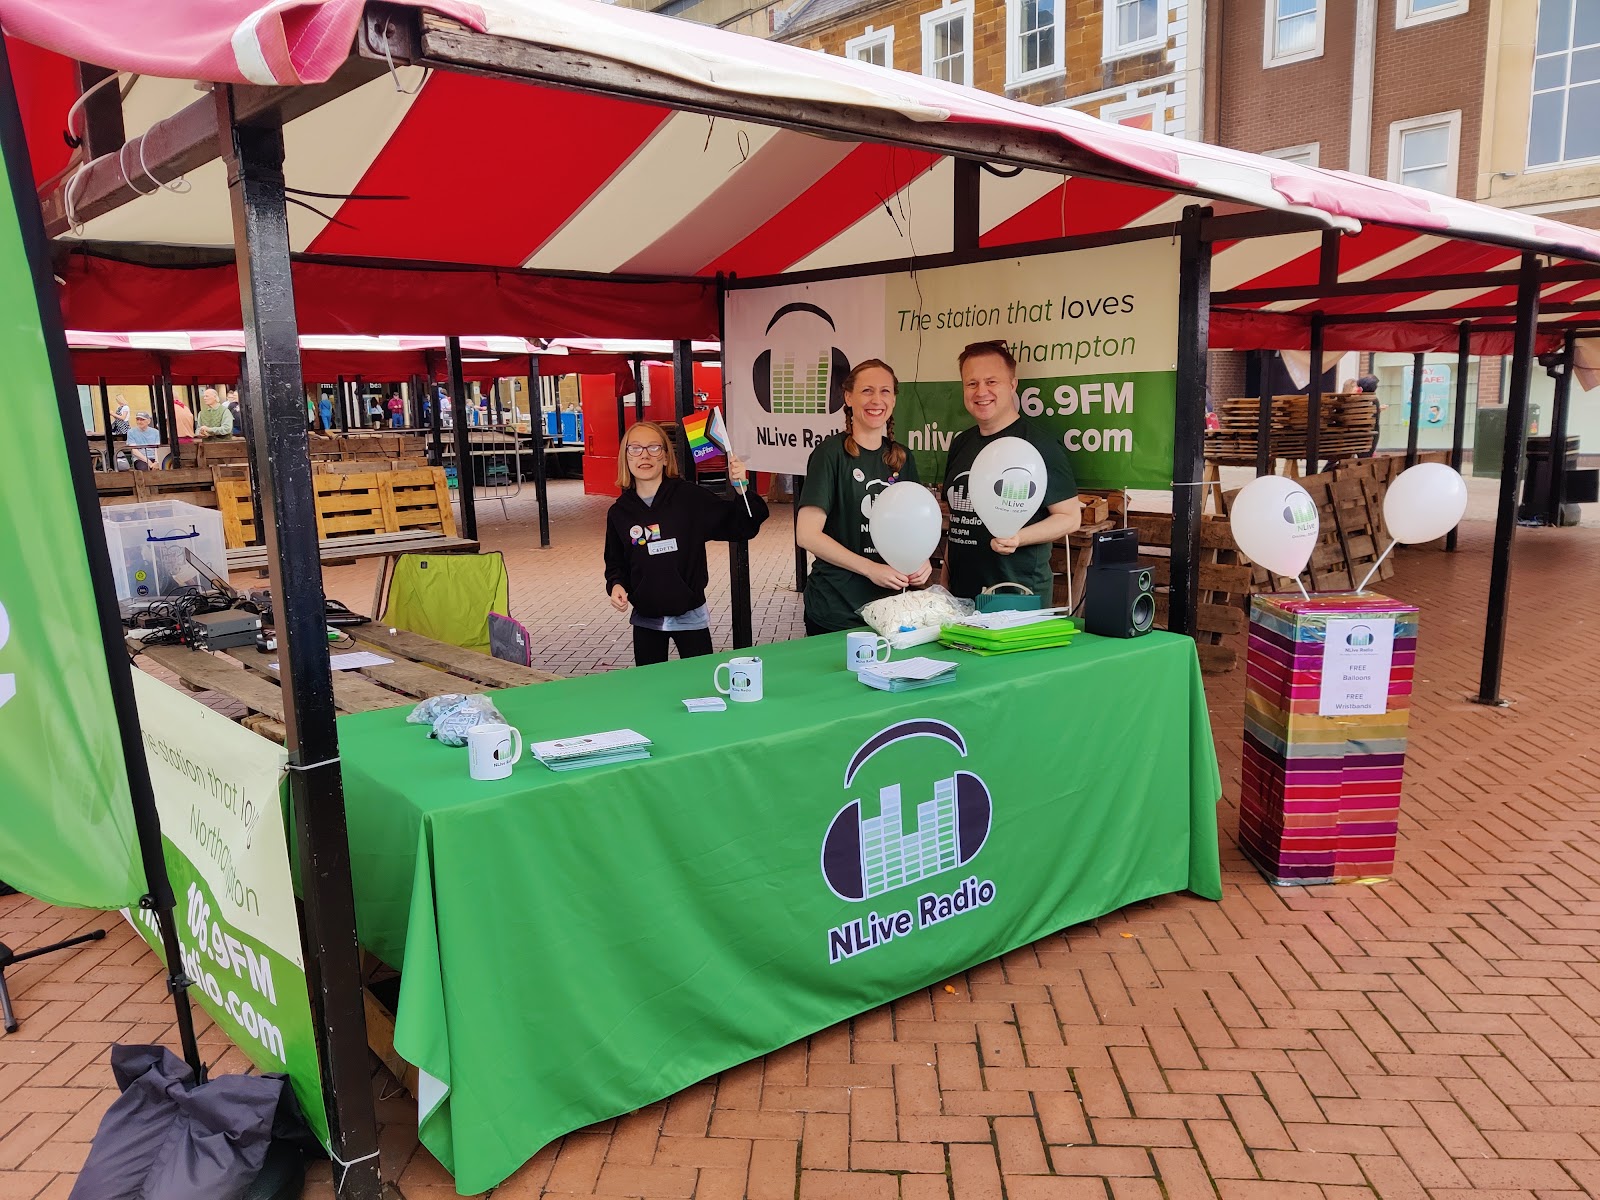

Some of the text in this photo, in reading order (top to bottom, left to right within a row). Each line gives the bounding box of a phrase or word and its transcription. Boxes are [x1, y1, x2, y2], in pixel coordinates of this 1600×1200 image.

[897, 294, 1135, 331] The station that loves
[1008, 335, 1136, 365] thampton
[1014, 381, 1134, 417] 6.9FM
[756, 426, 797, 448] NLive
[960, 515, 983, 526] Radio
[1001, 499, 1025, 508] NLive
[158, 739, 206, 790] station
[207, 767, 238, 816] that
[828, 876, 995, 964] NLive Radio
[187, 881, 278, 1007] 106.9FM
